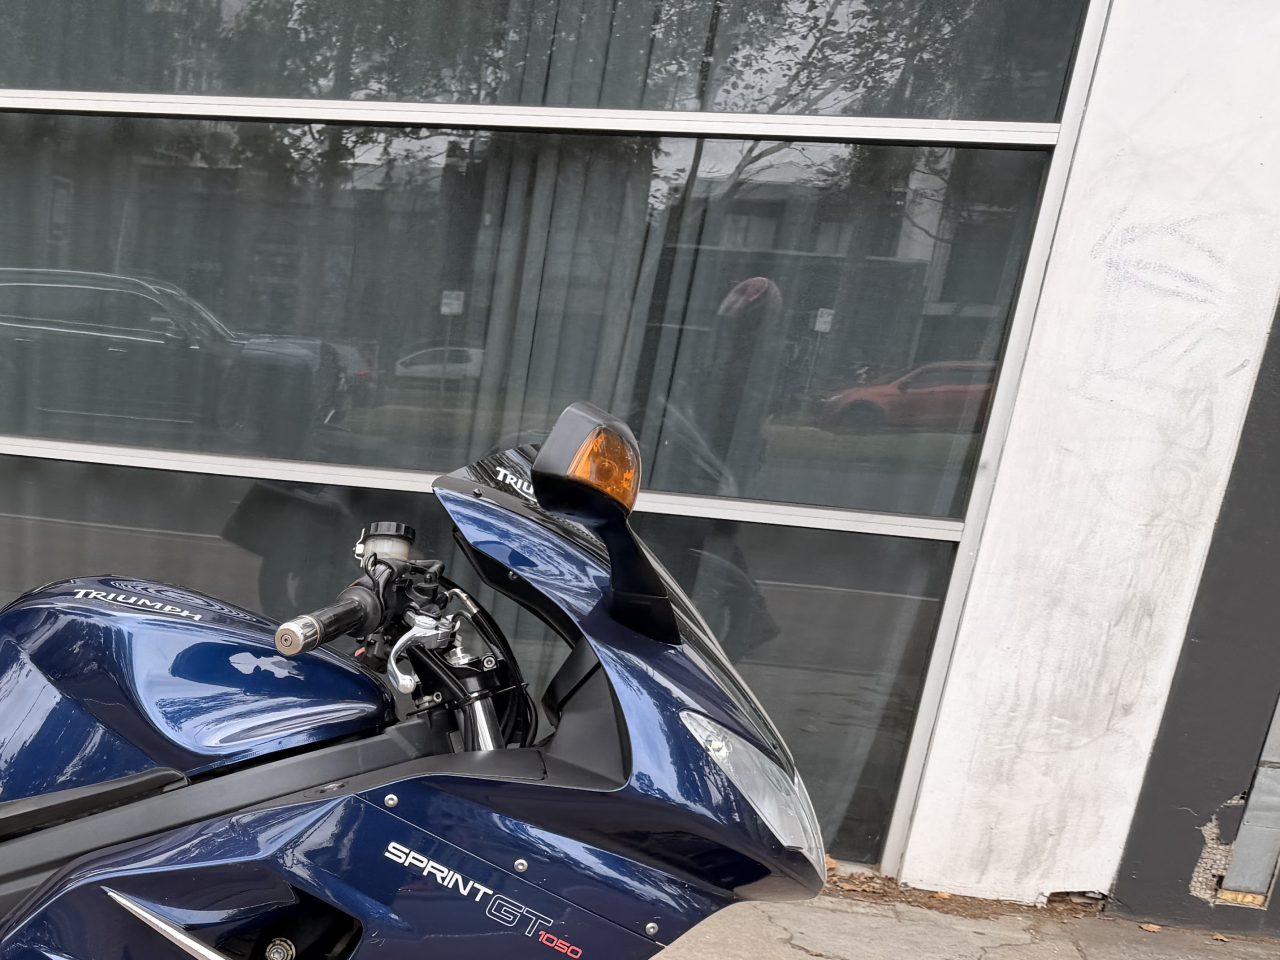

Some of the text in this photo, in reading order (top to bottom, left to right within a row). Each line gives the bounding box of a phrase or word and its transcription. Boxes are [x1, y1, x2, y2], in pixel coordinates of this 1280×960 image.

[496, 466, 535, 499] TRIU
[73, 589, 202, 621] TRIUMPH
[384, 841, 582, 960] SPRINT GT 1050
